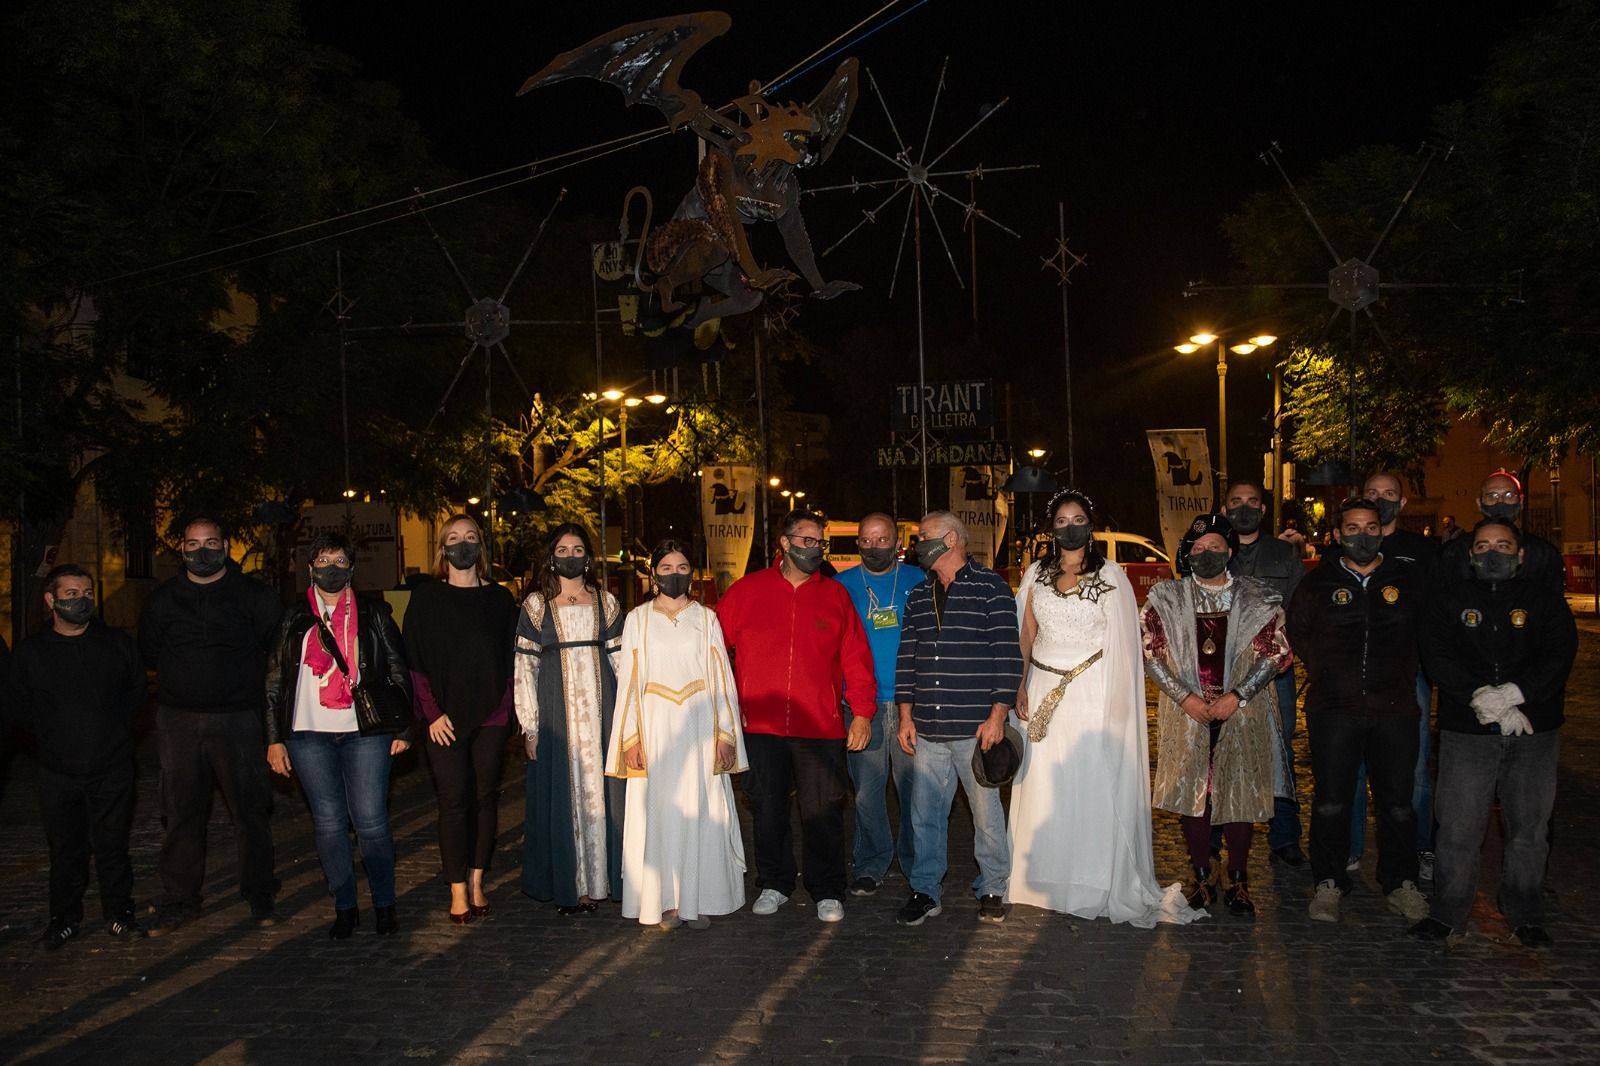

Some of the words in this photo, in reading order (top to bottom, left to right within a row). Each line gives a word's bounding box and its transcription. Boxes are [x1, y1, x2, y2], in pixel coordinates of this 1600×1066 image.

[599, 260, 625, 273] ANYS
[896, 383, 985, 415] TIRANT
[931, 412, 977, 428] LLETRA
[878, 447, 907, 466] NA
[1167, 496, 1209, 512] TIRANT
[957, 510, 1002, 527] TIRANT
[708, 524, 749, 539] TIRANT
